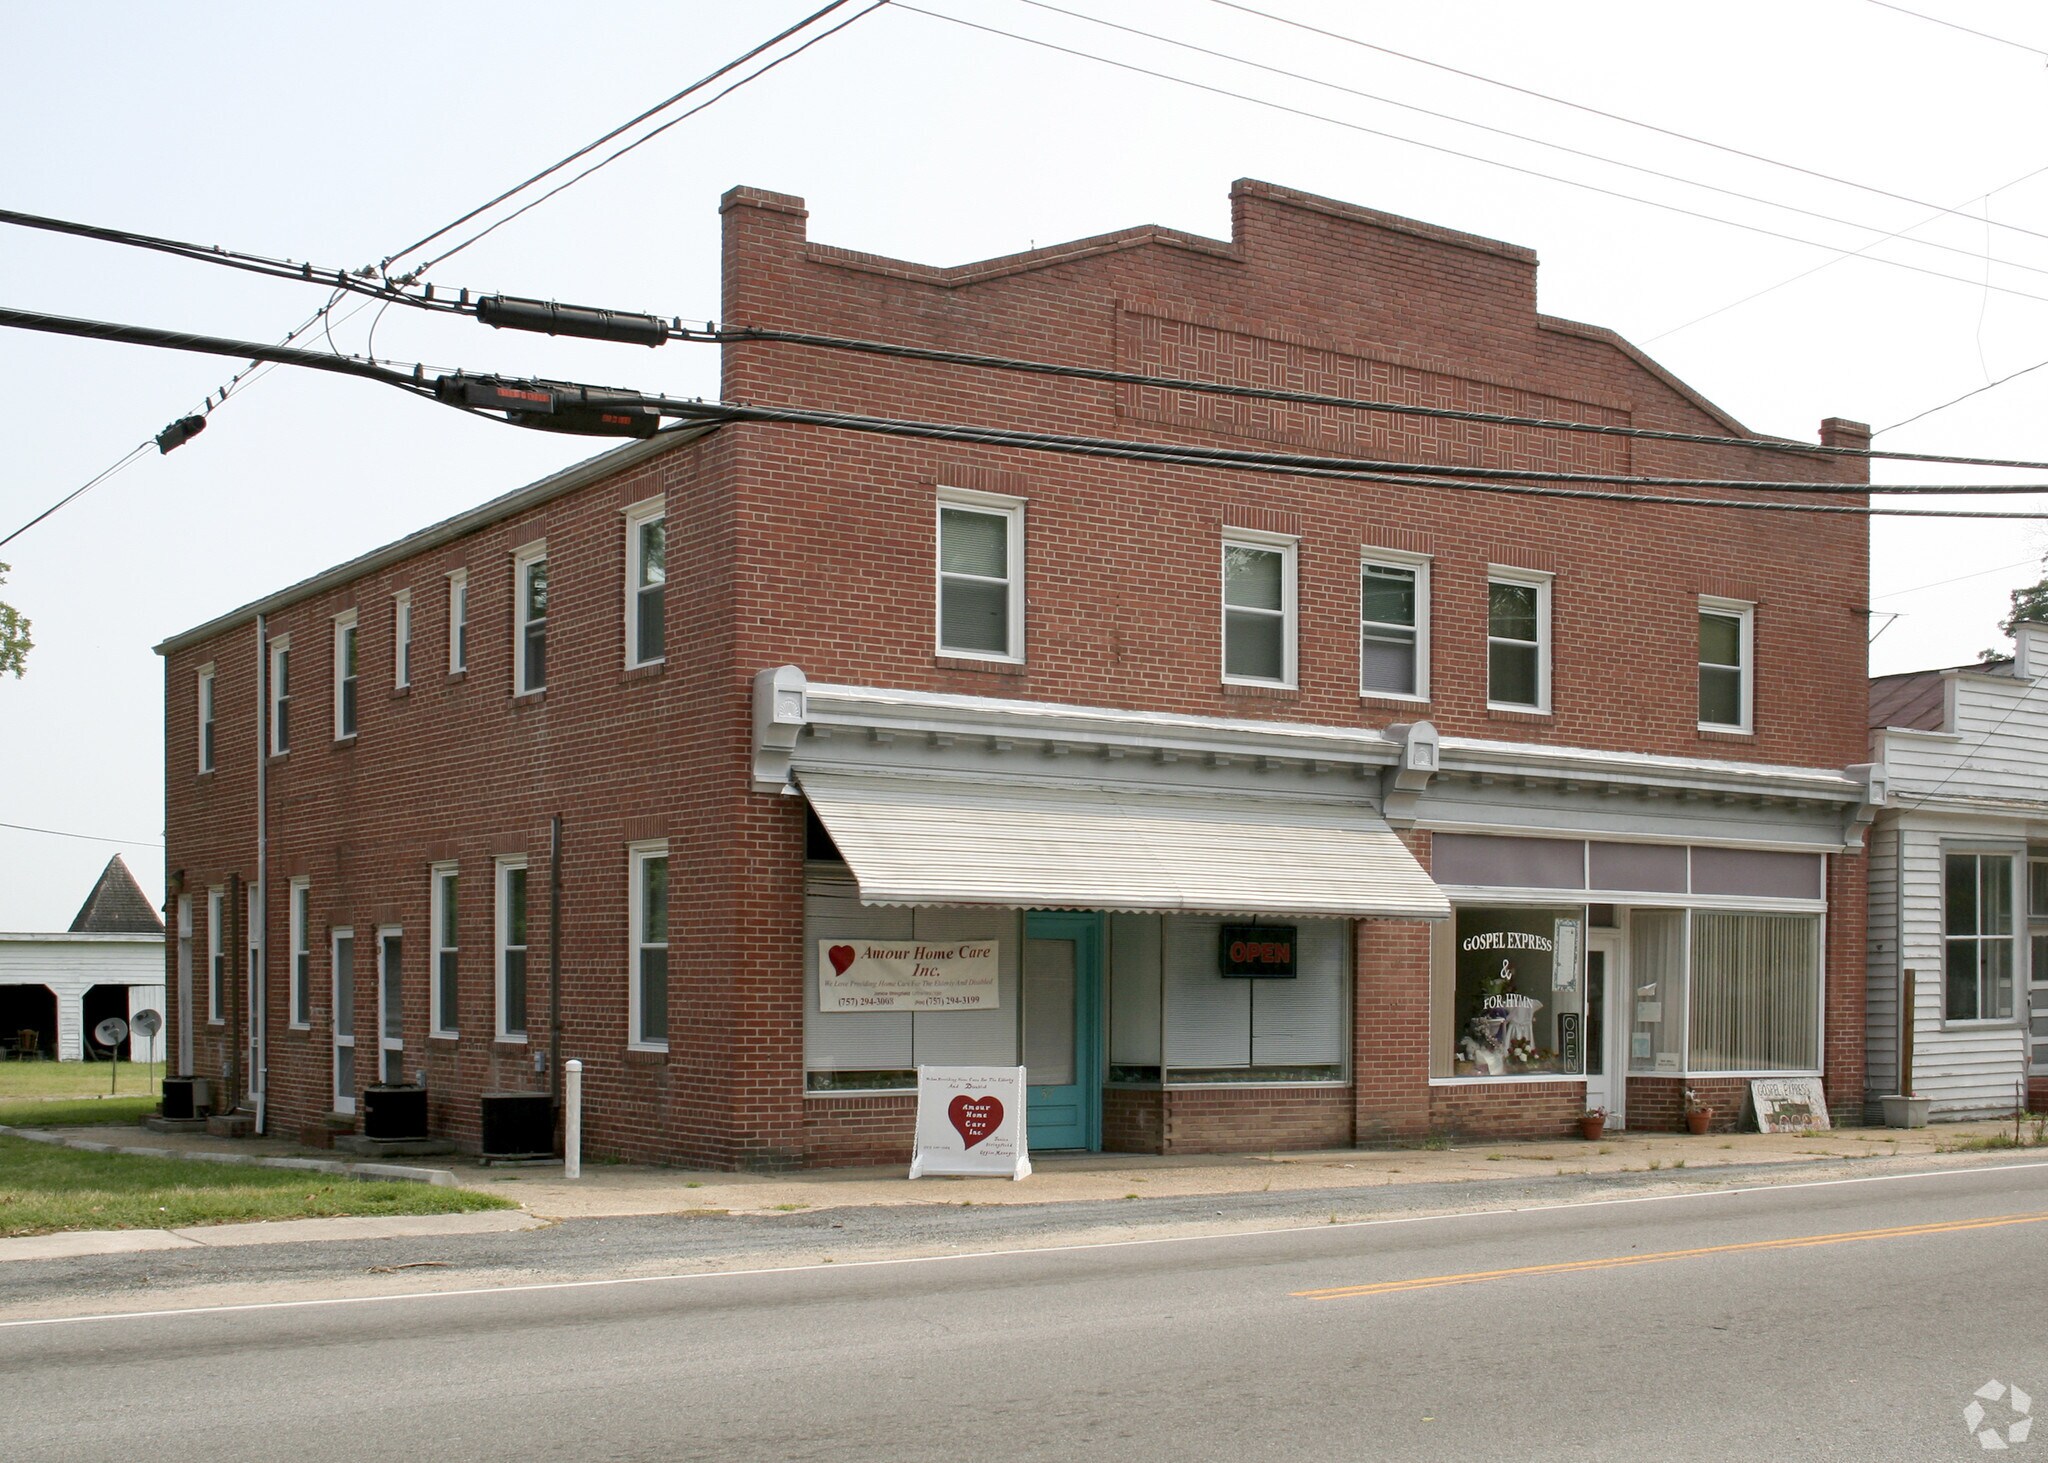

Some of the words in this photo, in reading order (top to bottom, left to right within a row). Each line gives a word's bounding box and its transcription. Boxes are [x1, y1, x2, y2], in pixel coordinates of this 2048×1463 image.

[1463, 932, 1505, 951] GOSPEL
[1507, 932, 1553, 952] EXPRESS
[860, 946, 910, 960] Amour
[914, 946, 954, 960] Home
[959, 945, 991, 959] Care
[1230, 941, 1291, 963] OPEN
[912, 963, 940, 977] Inc.
[1500, 959, 1513, 980] &
[838, 997, 858, 1007] (757)
[1565, 1017, 1577, 1071] OPEN
[965, 1120, 987, 1128] Care
